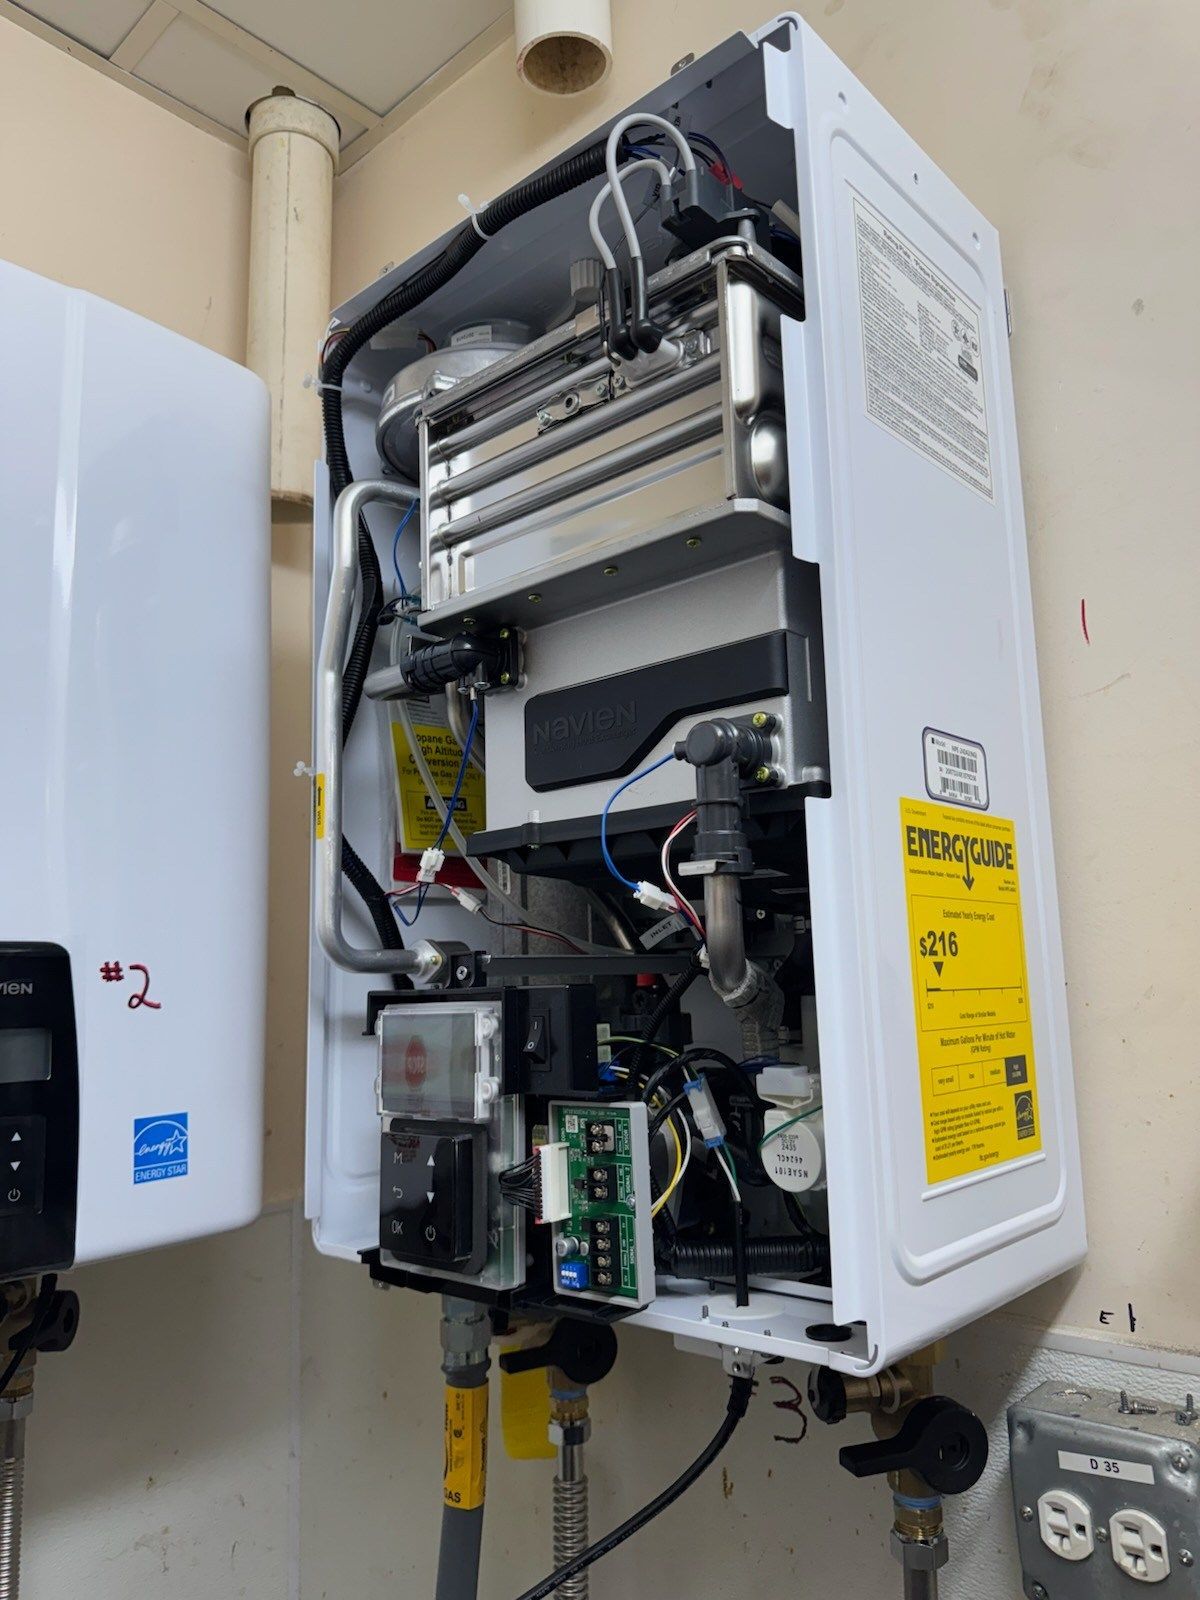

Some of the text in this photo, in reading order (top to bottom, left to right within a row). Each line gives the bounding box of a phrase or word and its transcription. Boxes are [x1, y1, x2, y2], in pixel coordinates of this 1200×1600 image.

[906, 825, 1014, 870] ENERGYGUIDE
[650, 921, 672, 938] INLET
[920, 930, 958, 958] $216
[100, 960, 162, 1009] #2
[393, 1153, 403, 1165] M
[135, 1164, 187, 1182] ENERGY STAR
[391, 1219, 403, 1235] OK
[769, 1375, 808, 1444] 3
[1089, 1457, 1120, 1474] D 35
